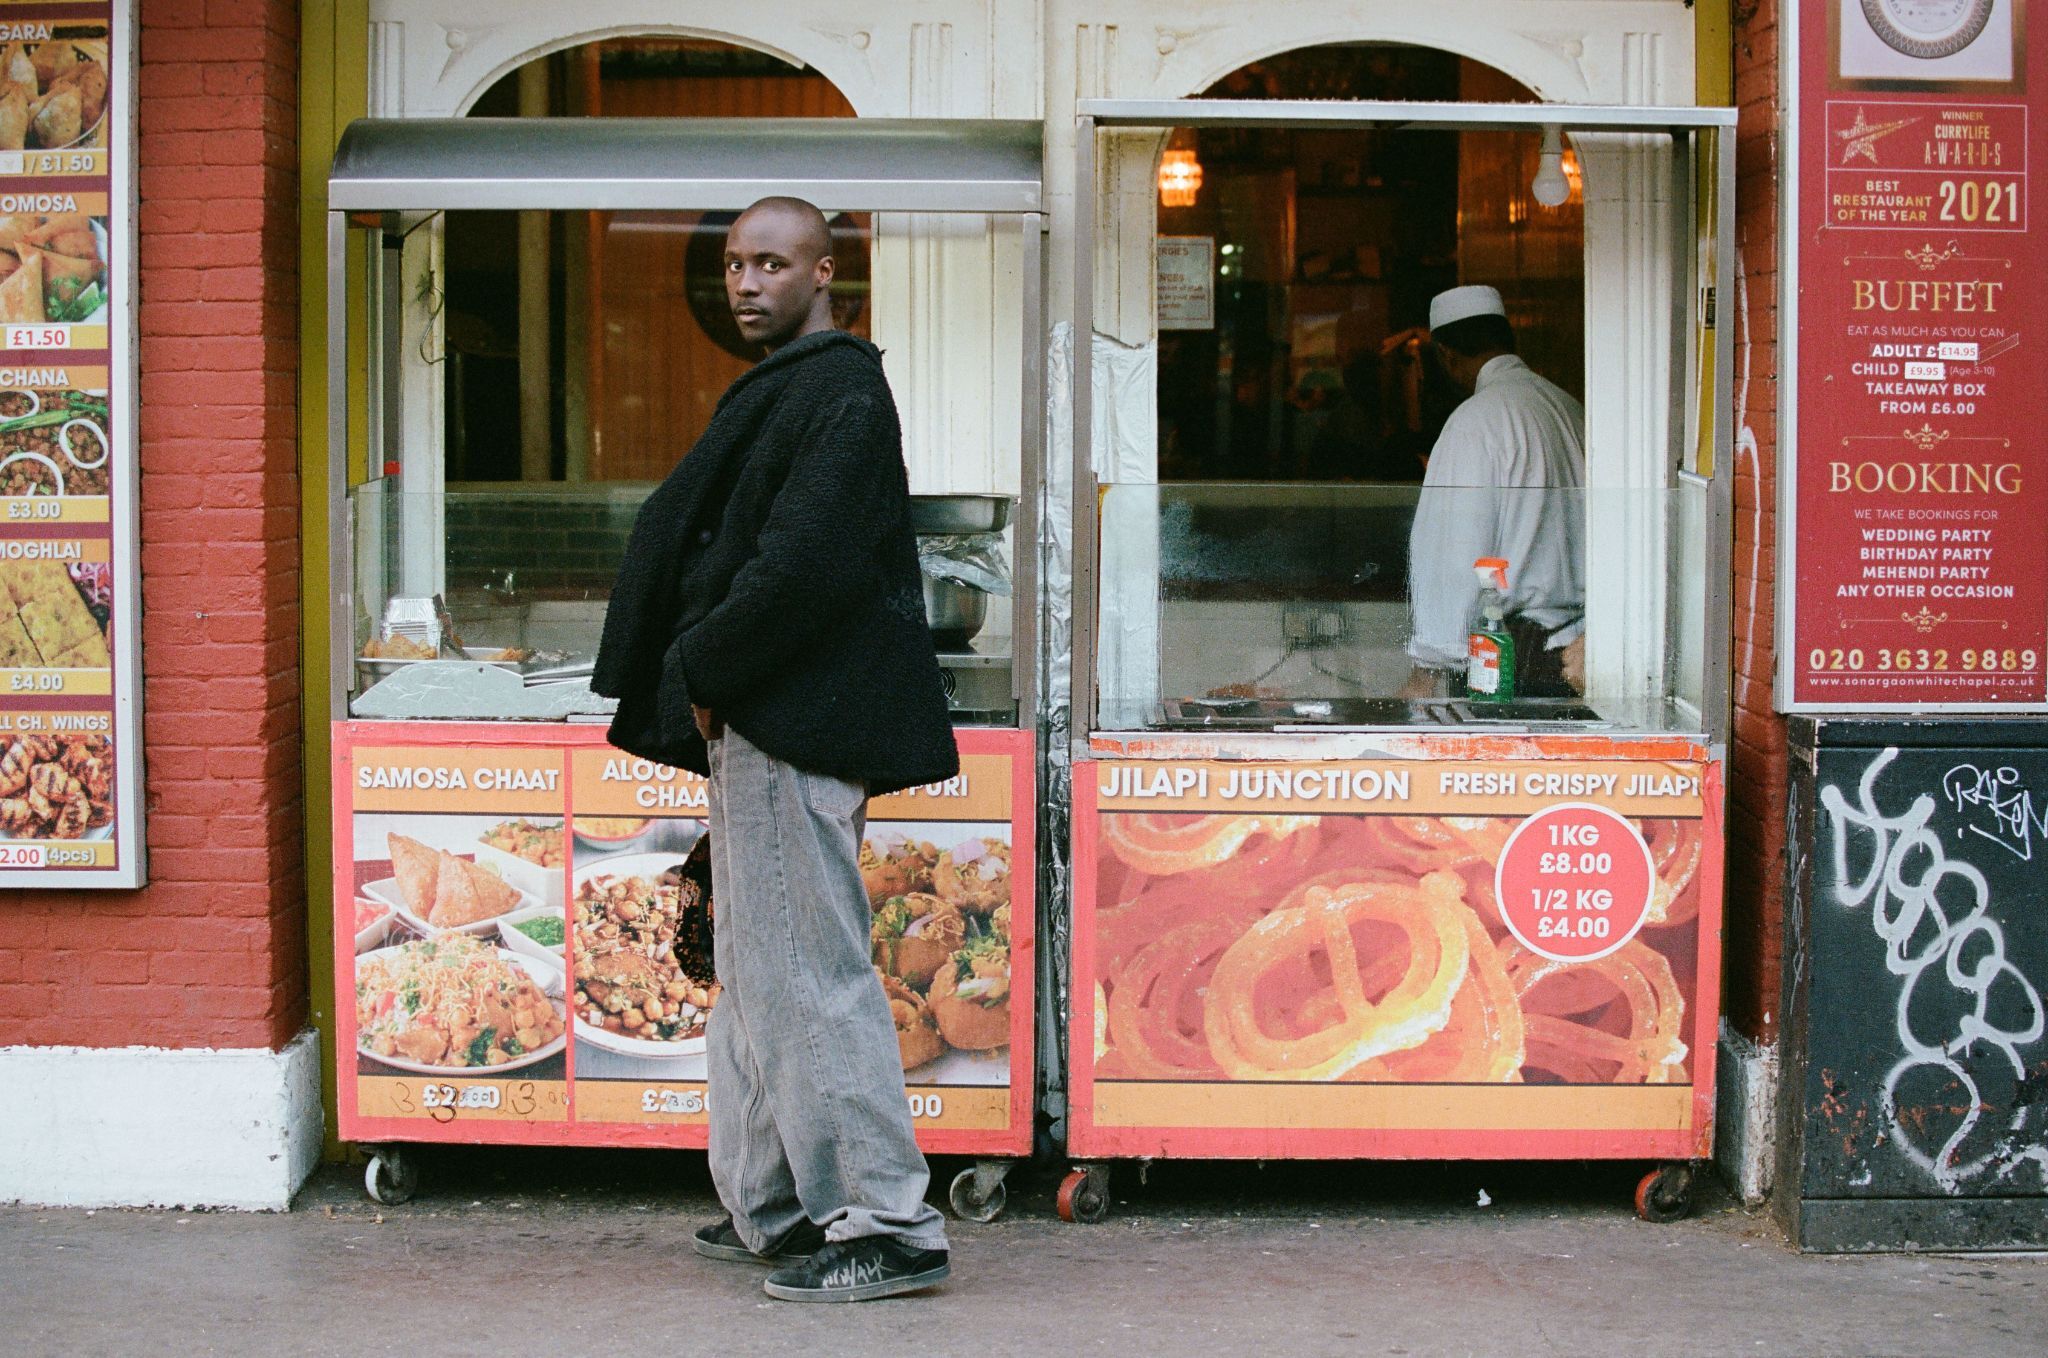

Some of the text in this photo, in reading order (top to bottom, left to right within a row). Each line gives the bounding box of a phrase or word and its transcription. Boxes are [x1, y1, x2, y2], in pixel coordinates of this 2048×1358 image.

[1942, 111, 1984, 121] WINNER
[41, 155, 94, 172] £1.50
[1866, 181, 1900, 192] BEST
[1833, 195, 1932, 207] RRESTAURANT
[1939, 180, 2017, 222] 2021
[1838, 209, 1927, 222] OF THE YEAR
[1852, 279, 2003, 313] BUFFET
[13, 330, 65, 346] £1.50
[1847, 325, 2004, 338] EAT AS MUCH AS YOU CAN
[1872, 344, 1921, 358] ADULT
[1941, 347, 1976, 358] £14.95
[1852, 363, 1899, 376] CHILD
[1910, 366, 1939, 377] £9.95
[1950, 366, 1970, 379] (Age
[0, 368, 70, 387] CHANA
[1865, 382, 1986, 396] TAKEAWAY BOX
[1880, 401, 1976, 415] FROM £6.00
[1829, 461, 2023, 494] BOOKING
[8, 502, 61, 519] £3.00
[1854, 509, 1998, 520] WE TAKE BOOKINGS FOR
[1862, 529, 1991, 542] WEDDING PARTY
[1860, 547, 1993, 561] BIRTHDAY PARTY
[1862, 566, 1990, 579] MEHENDI PARTY
[1836, 585, 2014, 598] ANY OTHER OCCASION
[1809, 649, 2037, 671] 020 3632 9889
[11, 674, 63, 691] £4.00
[1809, 675, 2035, 688] www.sonargaonwhitechapel.co.uk
[16, 715, 48, 730] CH.
[52, 715, 109, 731] WINGS
[601, 758, 676, 782] ALOO
[358, 766, 559, 791] SAMOSA CHAAT
[1100, 767, 1409, 800] JILAPI JUNCTION
[1440, 772, 1699, 797] FRESH CRISPY JILAPI
[45, 847, 96, 865] (4pcs)
[1540, 852, 1612, 874] £8.00
[1531, 888, 1613, 911] 1/2 KG
[1537, 917, 1610, 938] £4.00
